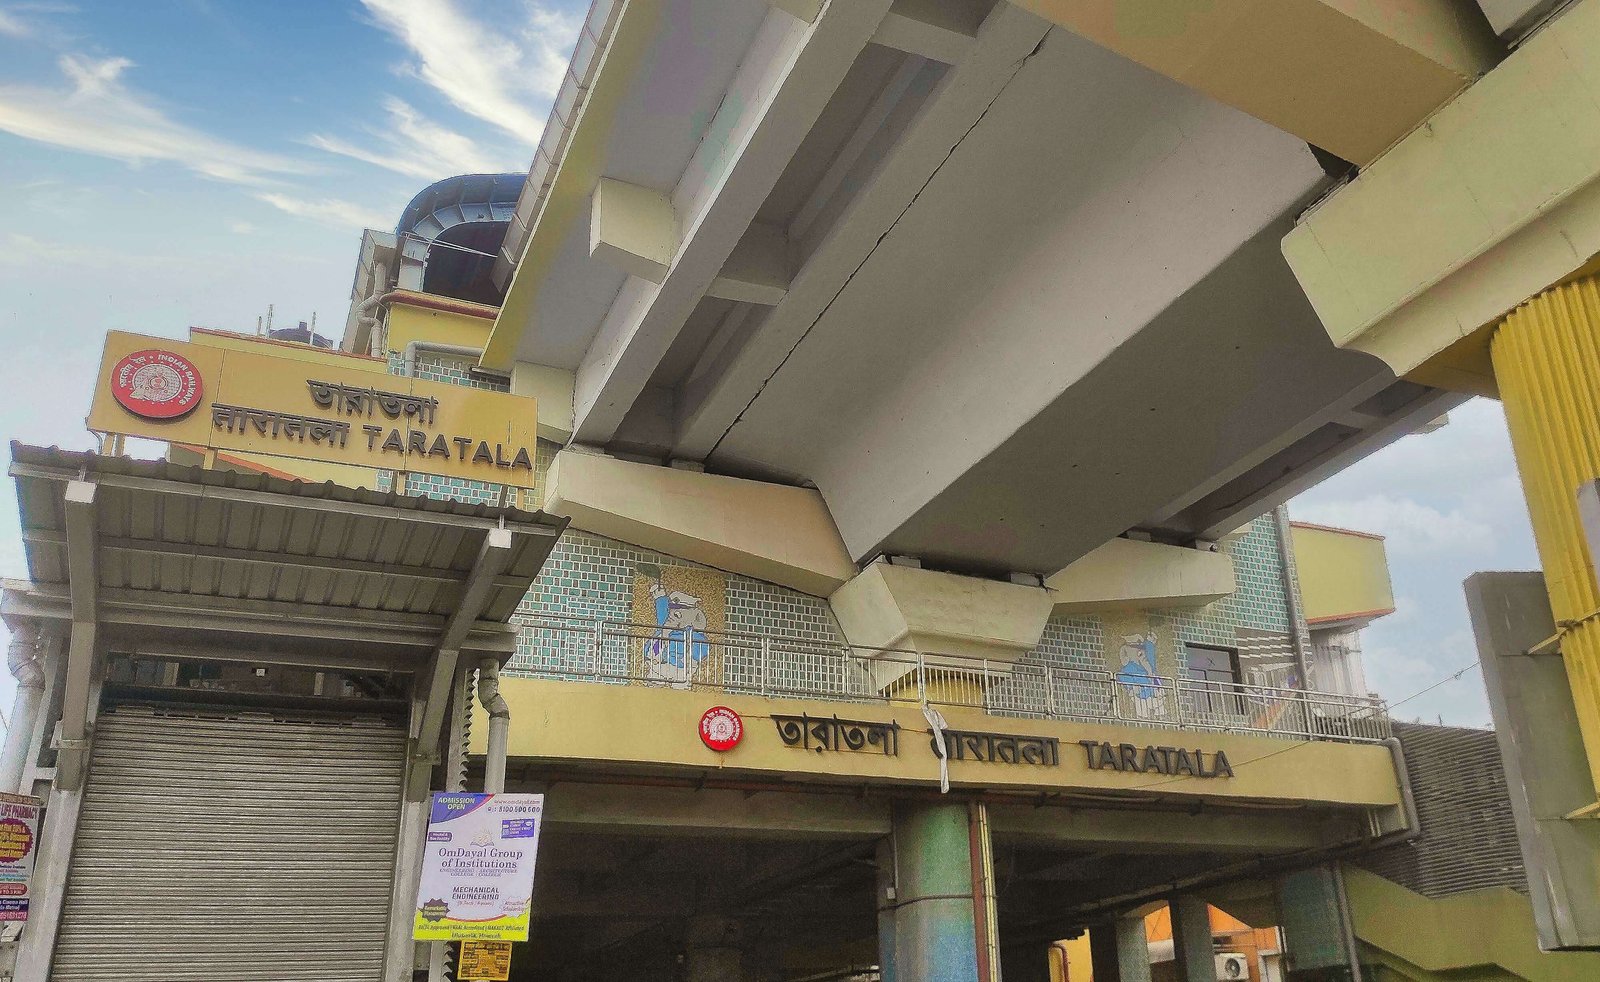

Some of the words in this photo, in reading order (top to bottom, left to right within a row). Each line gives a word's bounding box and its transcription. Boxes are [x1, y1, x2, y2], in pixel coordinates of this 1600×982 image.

[158, 354, 188, 371] INDIAN
[178, 370, 196, 406] RAILWAYS
[307, 379, 439, 425] তারাতলা
[212, 402, 351, 448] तारातला
[362, 424, 532, 470] TARATALA
[770, 711, 901, 757] তারাতলা
[1079, 740, 1234, 777] TARATALA
[438, 848, 487, 859] OmDayal
[490, 848, 523, 860] Group
[441, 859, 454, 868] of
[455, 859, 517, 868] Institutions
